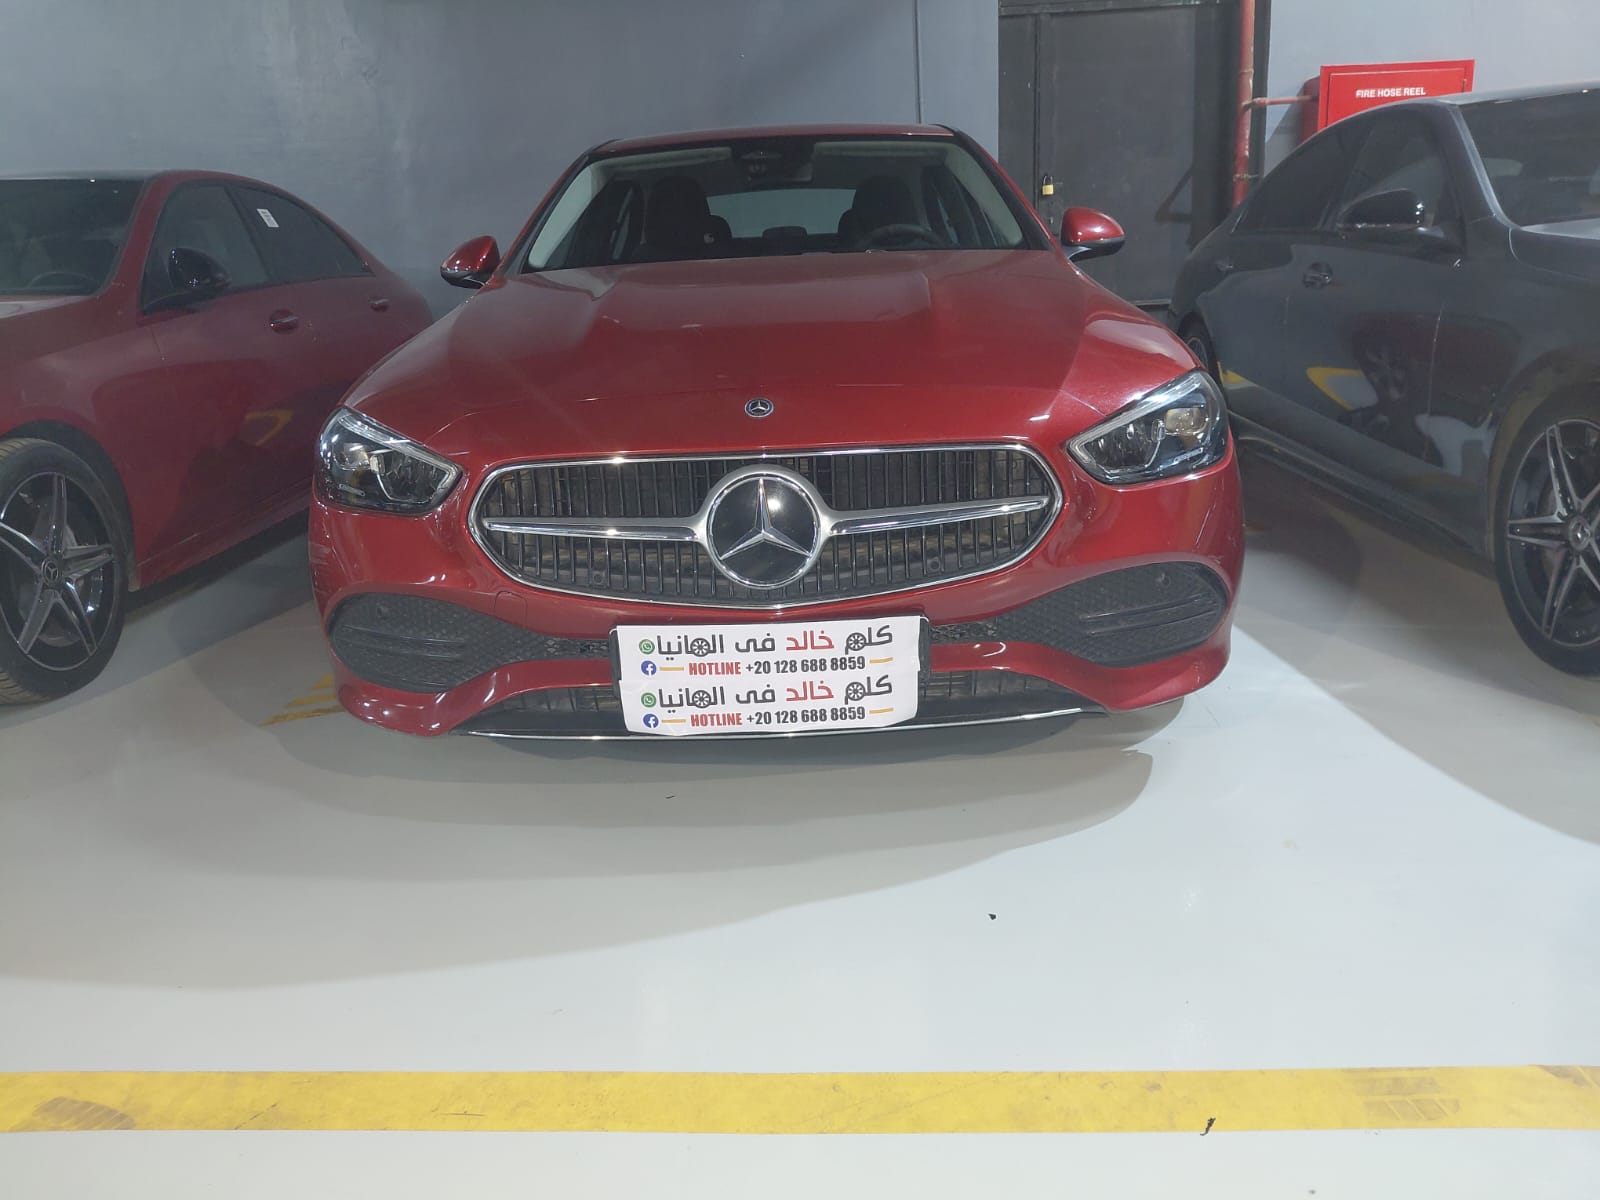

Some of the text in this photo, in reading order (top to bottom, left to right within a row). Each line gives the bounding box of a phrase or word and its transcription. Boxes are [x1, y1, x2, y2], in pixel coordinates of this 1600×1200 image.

[1356, 87, 1427, 98] FIRE HOSE REEL
[786, 630, 835, 651] خالد
[689, 656, 865, 675] HOTLINE +20 128 688 8859
[786, 680, 834, 701] خالد
[690, 706, 865, 726] HOTLINE +20 128 688 8859
